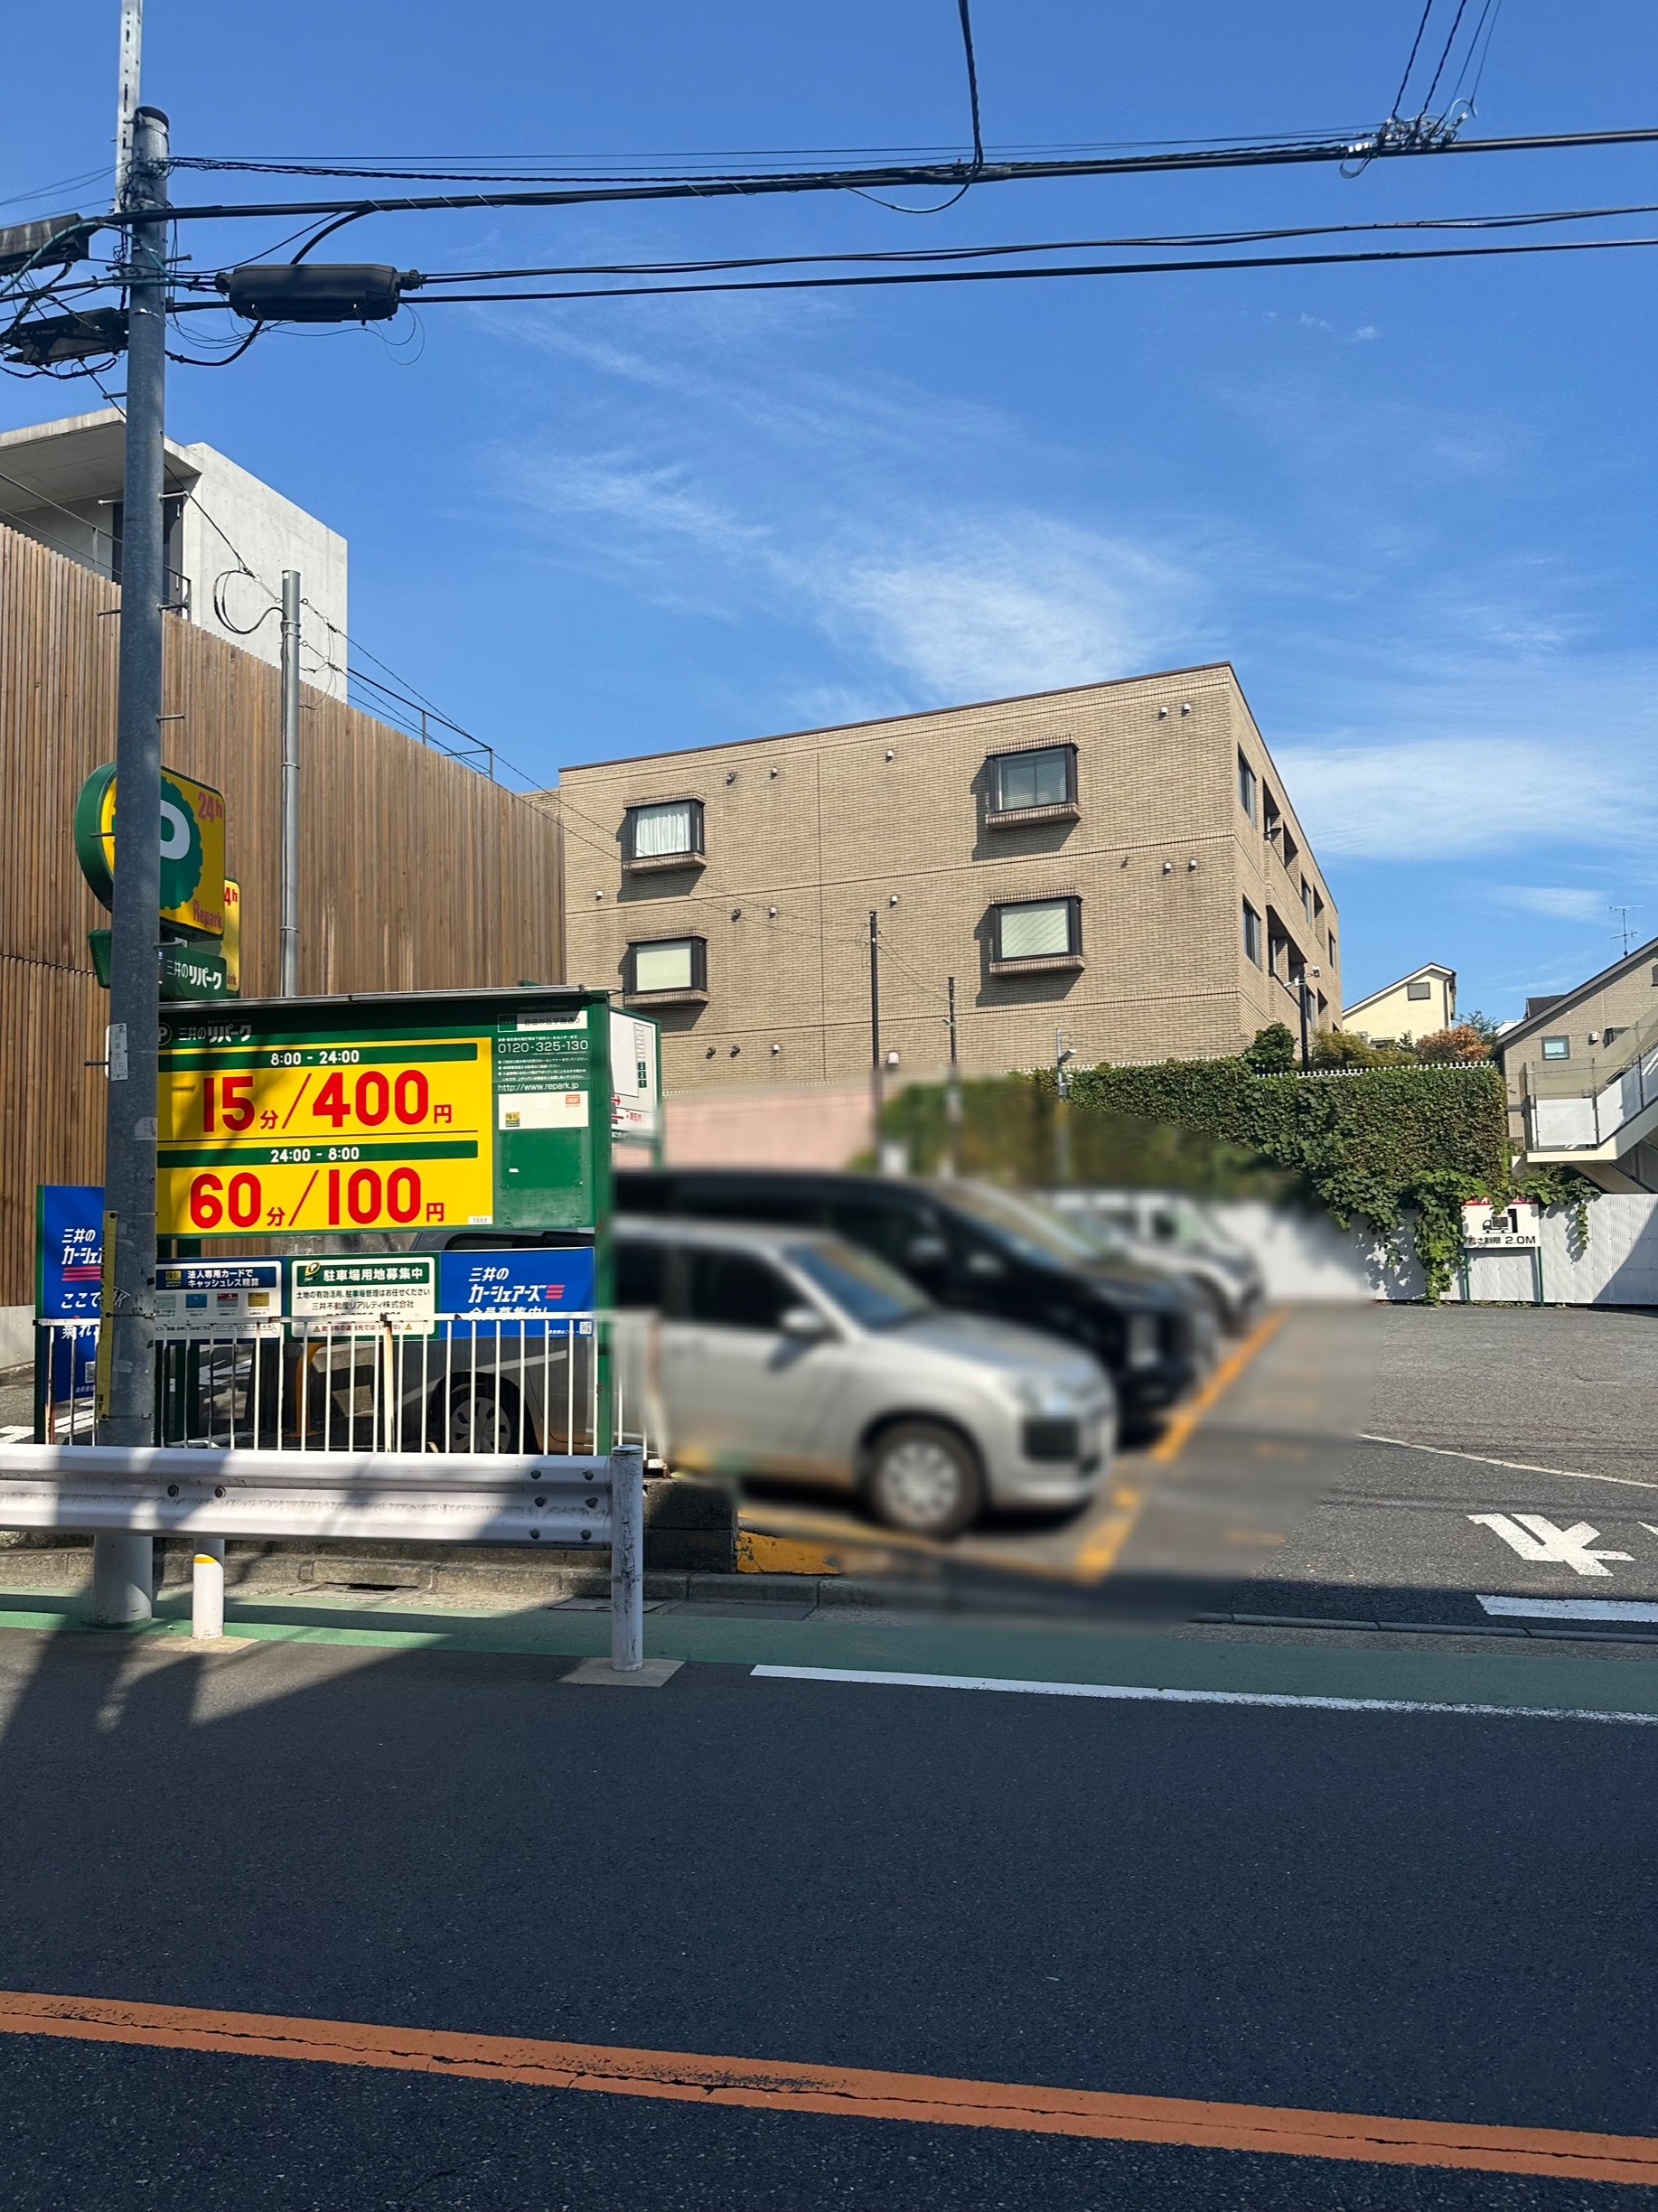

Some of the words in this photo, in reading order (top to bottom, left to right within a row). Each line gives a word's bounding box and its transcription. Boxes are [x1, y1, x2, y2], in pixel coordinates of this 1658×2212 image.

[198, 792, 222, 823] 24h
[224, 886, 238, 905] 4h
[193, 899, 222, 930] Repark
[166, 959, 222, 990] 三井のリパーク
[178, 1023, 252, 1044] 三井のリパーク
[497, 1040, 589, 1054] 0120-325-130
[271, 1053, 301, 1065] 8:00
[319, 1050, 360, 1064] 24:00
[497, 1082, 579, 1092] http://www.repark.jp
[271, 1148, 311, 1163] 24:00
[328, 1147, 360, 1161] 8:00
[61, 1228, 97, 1244] 三井の
[1505, 1236, 1536, 1244] 2.0M
[187, 1269, 254, 1279] 法人専用カードで
[323, 1267, 424, 1282] 駐車場用地募集中
[468, 1267, 510, 1282] 三井の
[187, 1278, 260, 1289] キャッシュレス精算
[467, 1284, 548, 1304] カーシェアーズ
[311, 1300, 415, 1310] 三井不動産リアルティ株式会社
